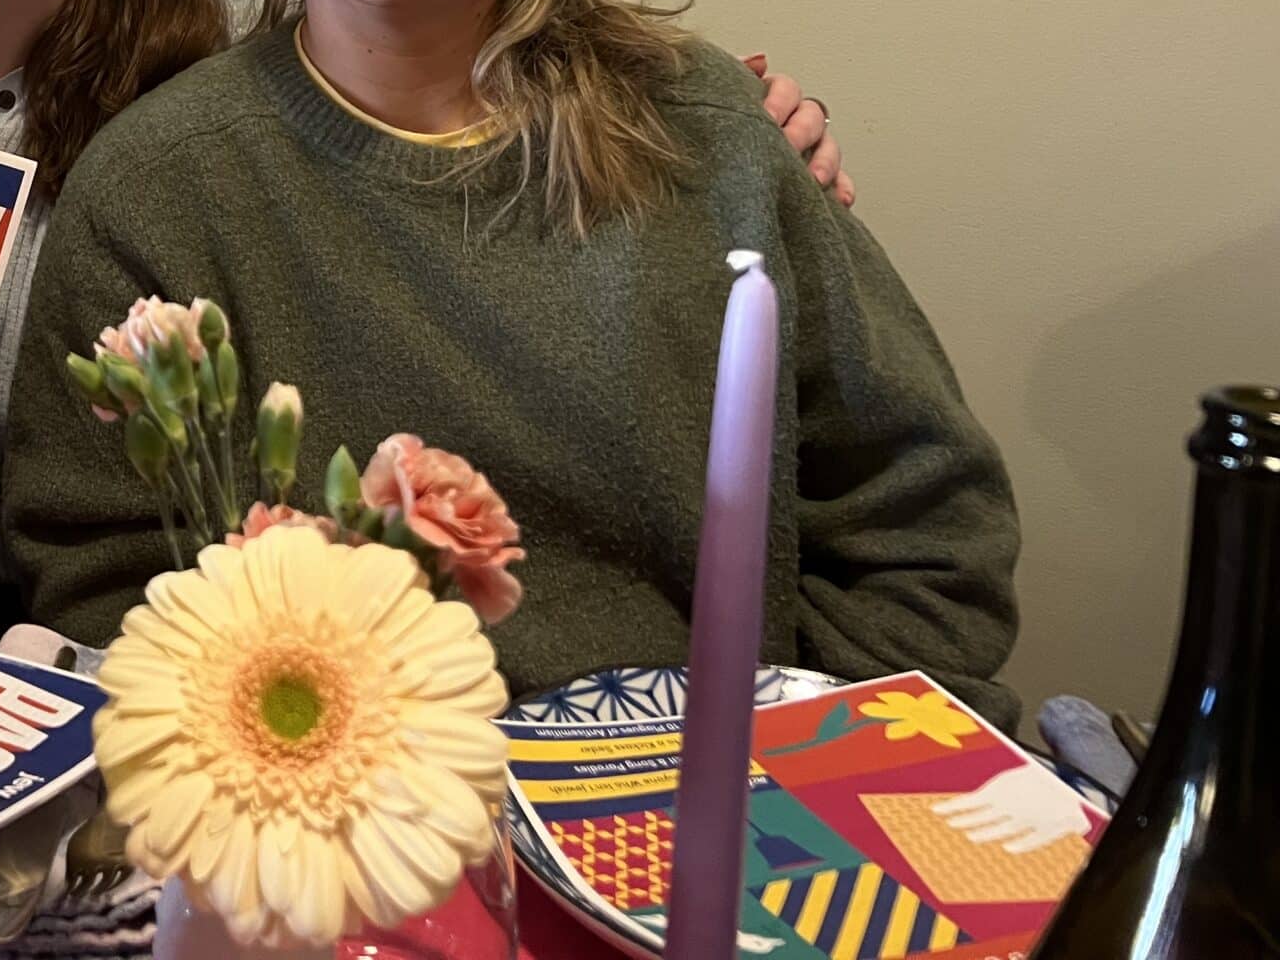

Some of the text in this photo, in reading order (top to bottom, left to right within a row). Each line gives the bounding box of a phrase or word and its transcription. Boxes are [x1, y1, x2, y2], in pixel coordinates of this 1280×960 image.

[534, 727, 605, 738] Antisemitism
[607, 727, 620, 737] of
[620, 723, 666, 735] Plagues
[572, 762, 626, 775] Parodies
[624, 759, 657, 771] Song
